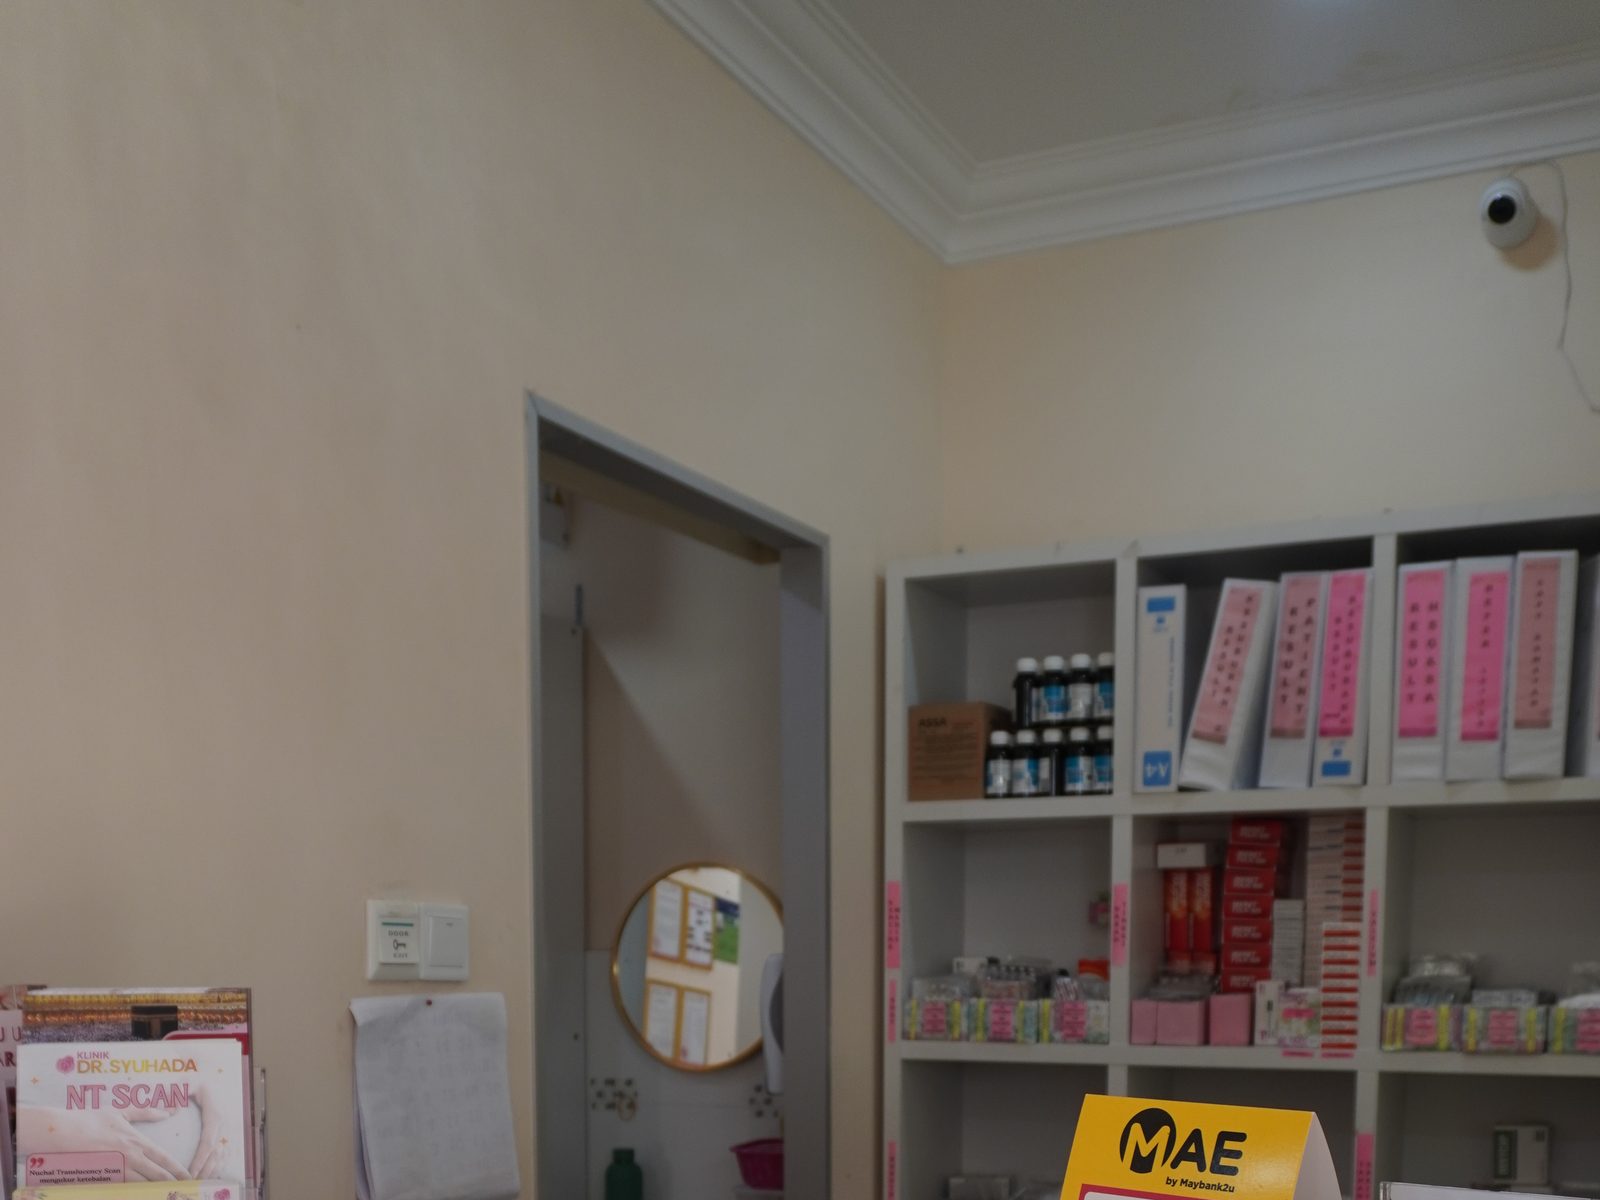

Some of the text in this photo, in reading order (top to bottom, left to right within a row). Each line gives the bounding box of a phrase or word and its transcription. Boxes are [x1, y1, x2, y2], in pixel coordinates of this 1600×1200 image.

[1406, 602, 1420, 704] RESULT
[77, 1051, 109, 1059] KLINIK
[77, 1059, 198, 1073] DR.SYUHADA
[66, 1083, 189, 1110] NT SCAN
[1120, 1107, 1247, 1177] MAE
[1165, 1176, 1235, 1193] by Maybank2u
